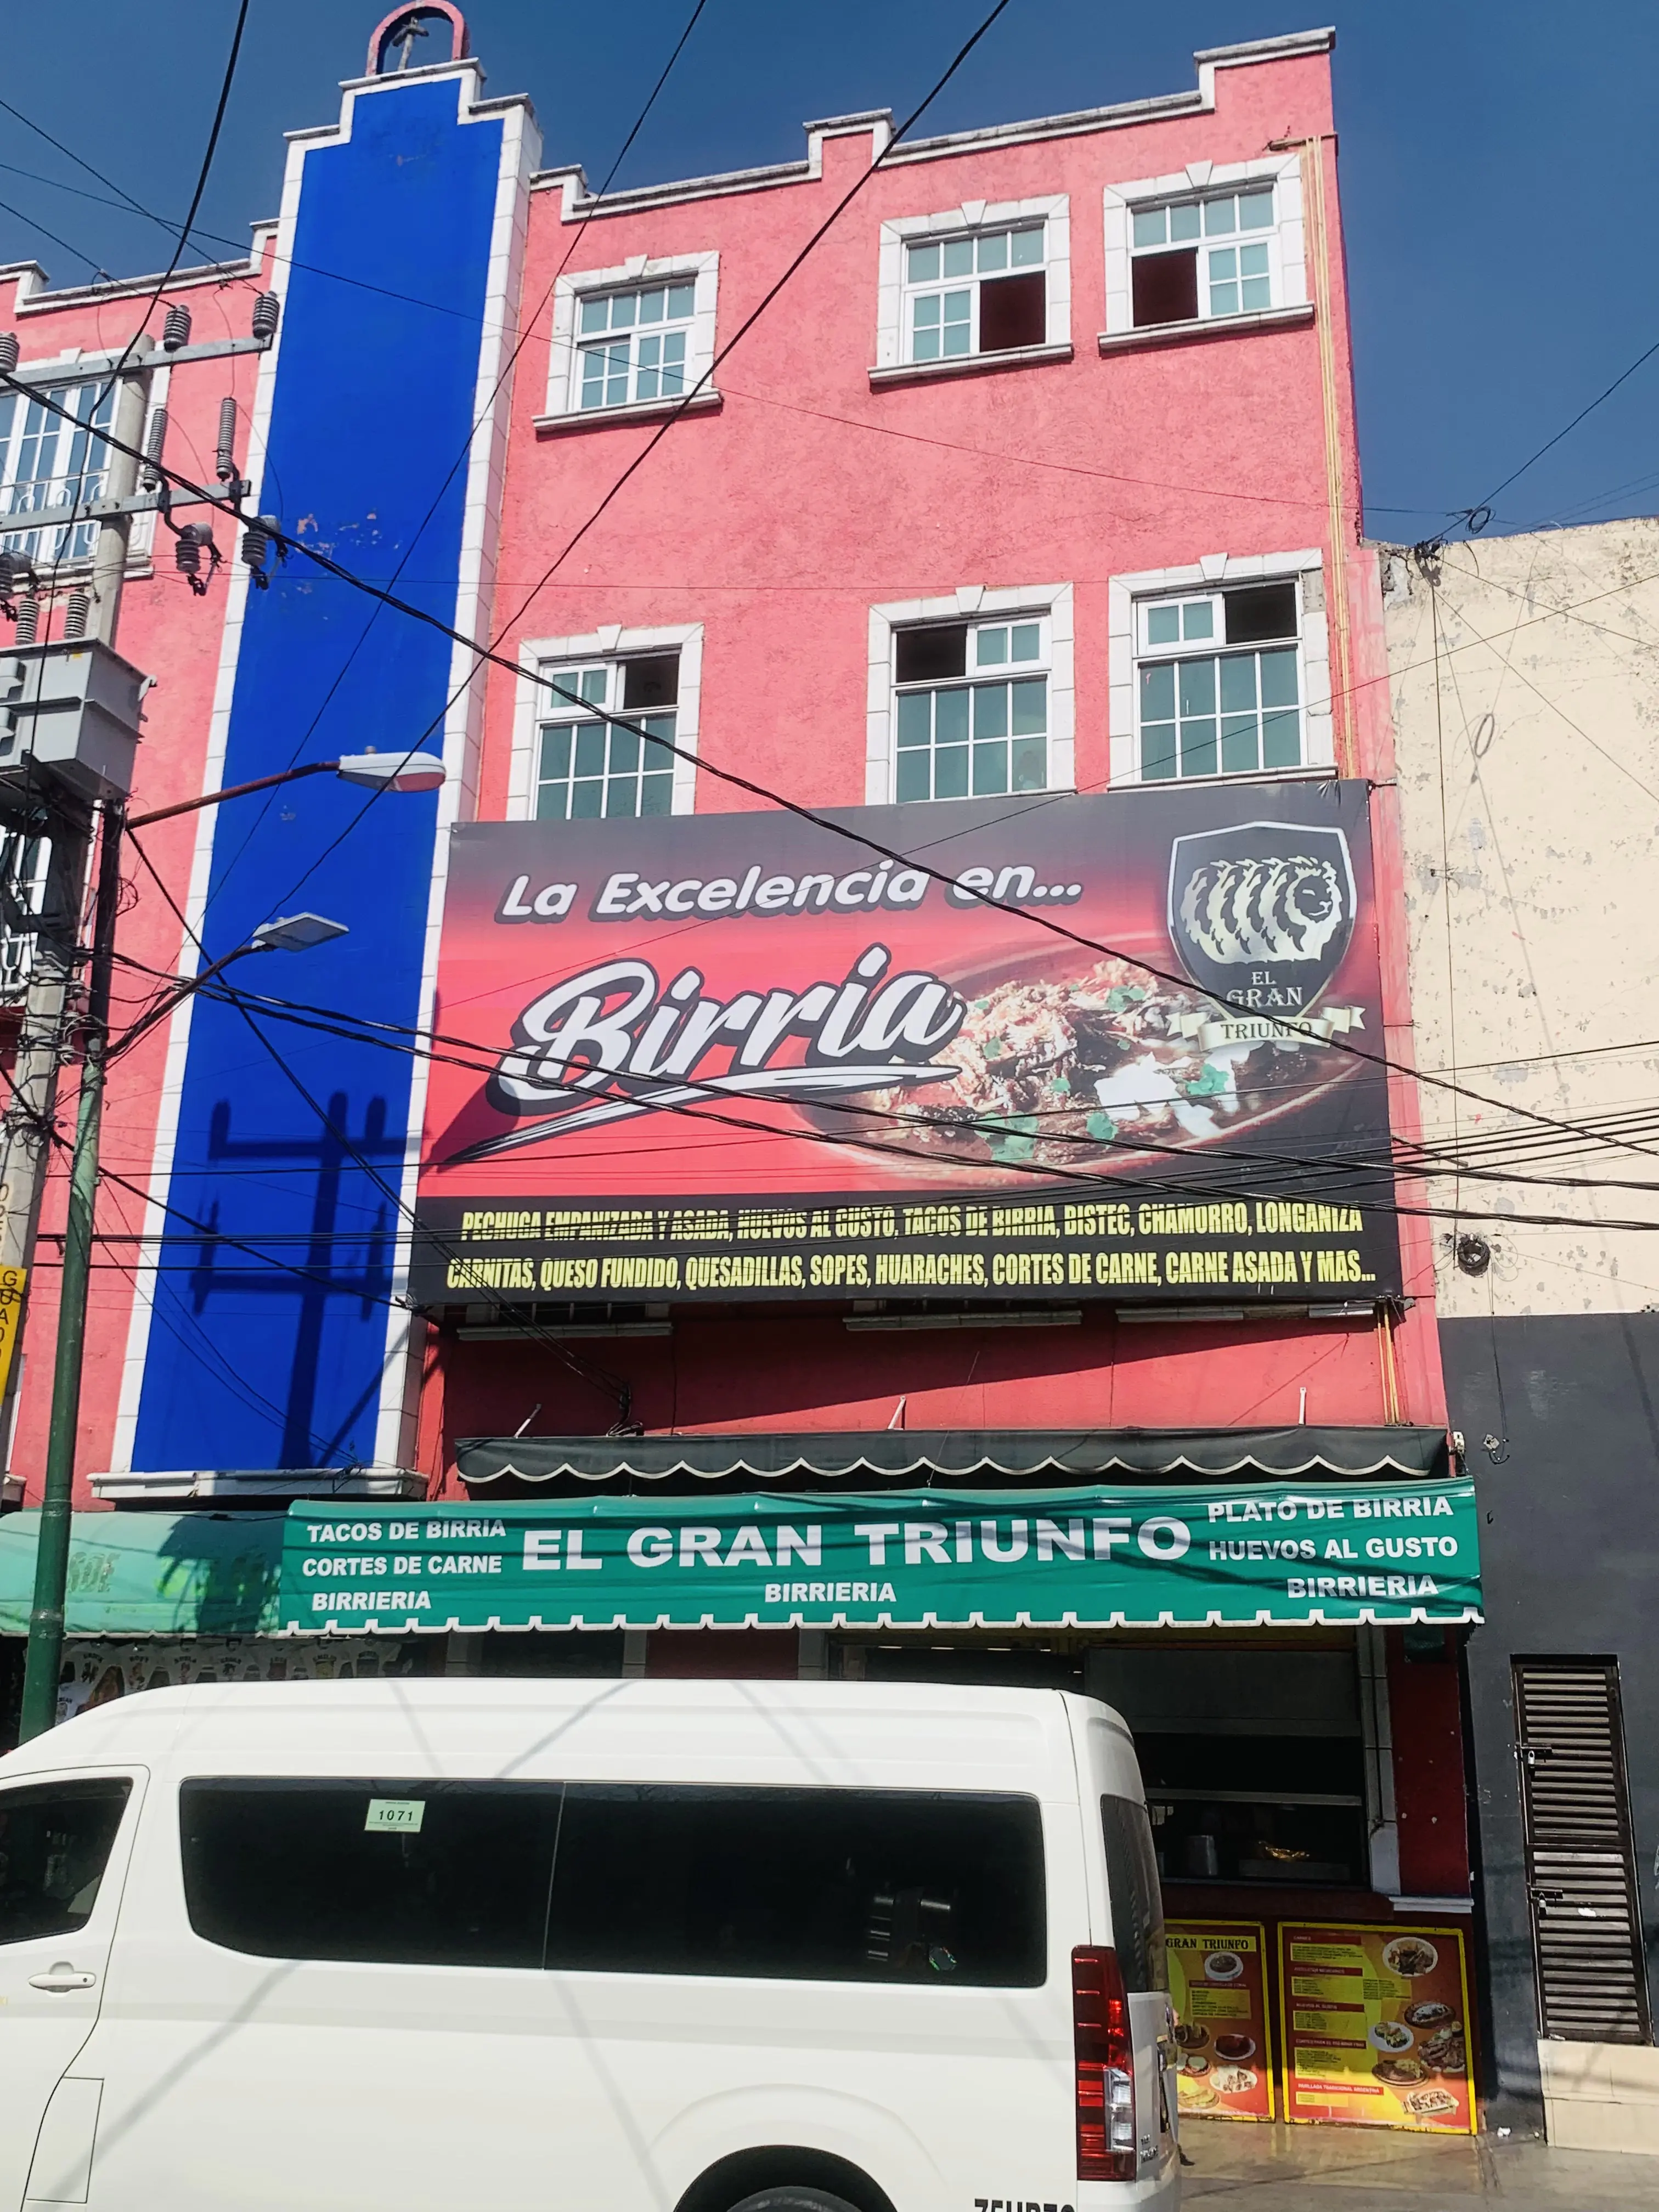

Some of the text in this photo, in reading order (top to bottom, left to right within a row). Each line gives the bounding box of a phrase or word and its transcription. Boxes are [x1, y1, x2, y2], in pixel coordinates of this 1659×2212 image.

[501, 858, 1082, 918] La Excelencia en...
[1251, 970, 1277, 985] EL
[1226, 986, 1303, 1007] GRAN
[495, 945, 964, 1102] Birria
[462, 1202, 1363, 1243] PECHUGA EMPANIZADA Y ASADA, HUEVOS AL GUSTO, TACOS DE BIRRIA, BISTEC, CHAMORRO, LONGANIZA
[447, 1250, 1375, 1291] CARNITAS, QUESO FUNDIDO, QUESADILLAS, SOPES, HUARACHES, CORTES DE CARNE, CARNE ASADA Y MAS...
[1207, 1496, 1455, 1523] PLATO DE BIRRIA
[306, 1520, 506, 1543] TACOS DE BIRRIA
[522, 1516, 1192, 1571] EL GRAN TRIUNFO
[1209, 1536, 1458, 1561] HUEVOS AL GUSTO
[302, 1555, 503, 1577] CORTES DE CARNE
[764, 1582, 897, 1603] BIRRIERIA
[1286, 1575, 1440, 1599] BIRRIERIA
[312, 1590, 432, 1612] BIRRIERIA
[379, 1809, 413, 1821] 1071
[1165, 1938, 1249, 1950] GRAN TRIUNFO
